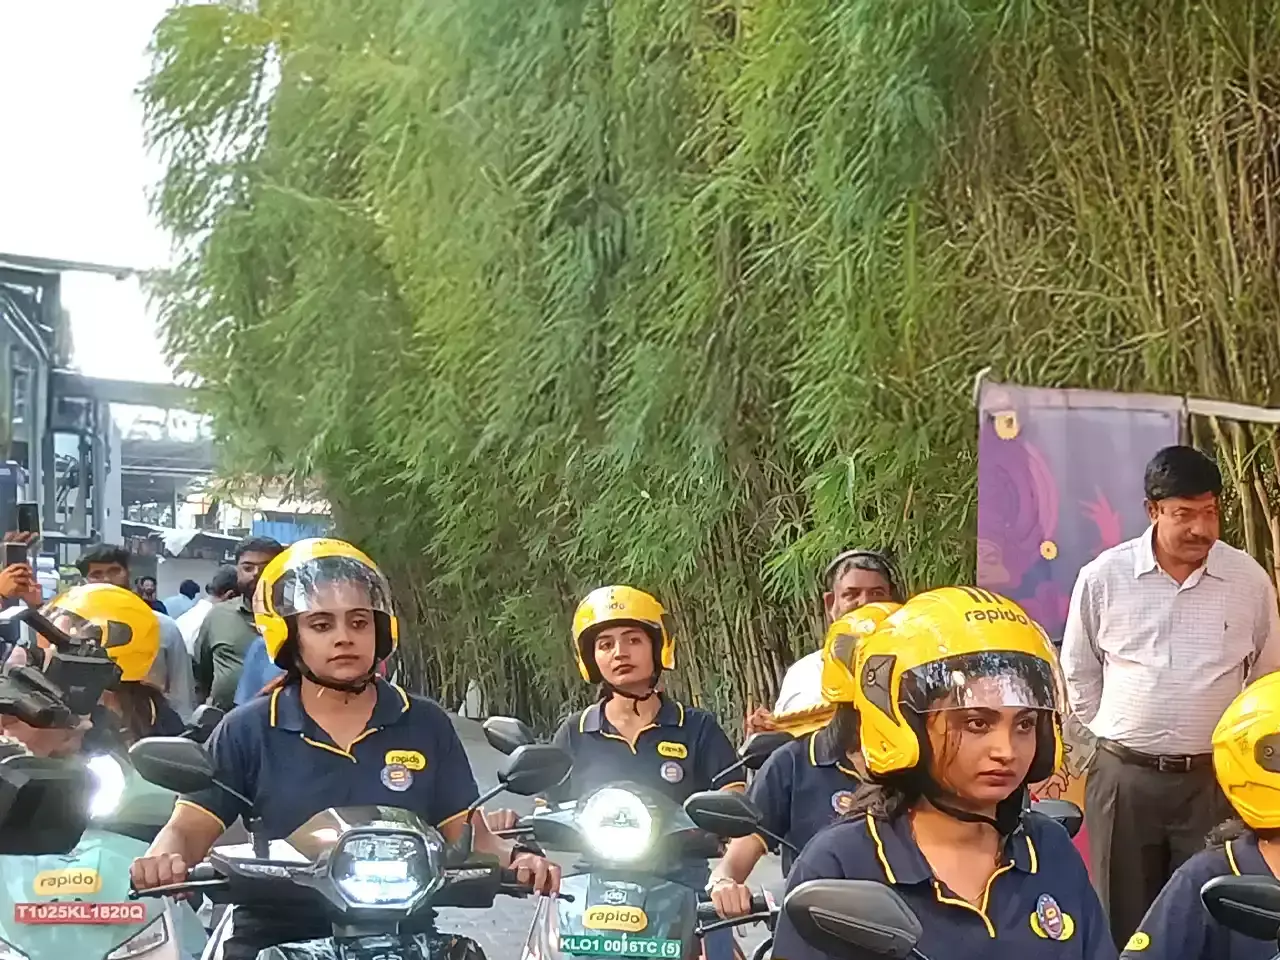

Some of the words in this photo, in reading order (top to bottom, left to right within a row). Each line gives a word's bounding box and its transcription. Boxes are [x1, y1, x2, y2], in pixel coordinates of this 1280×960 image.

[964, 607, 1028, 625] rapido
[40, 873, 94, 888] rapido
[17, 904, 144, 920] T1025KL1820Q
[589, 910, 641, 924] rapido
[661, 942, 681, 957] (5)
